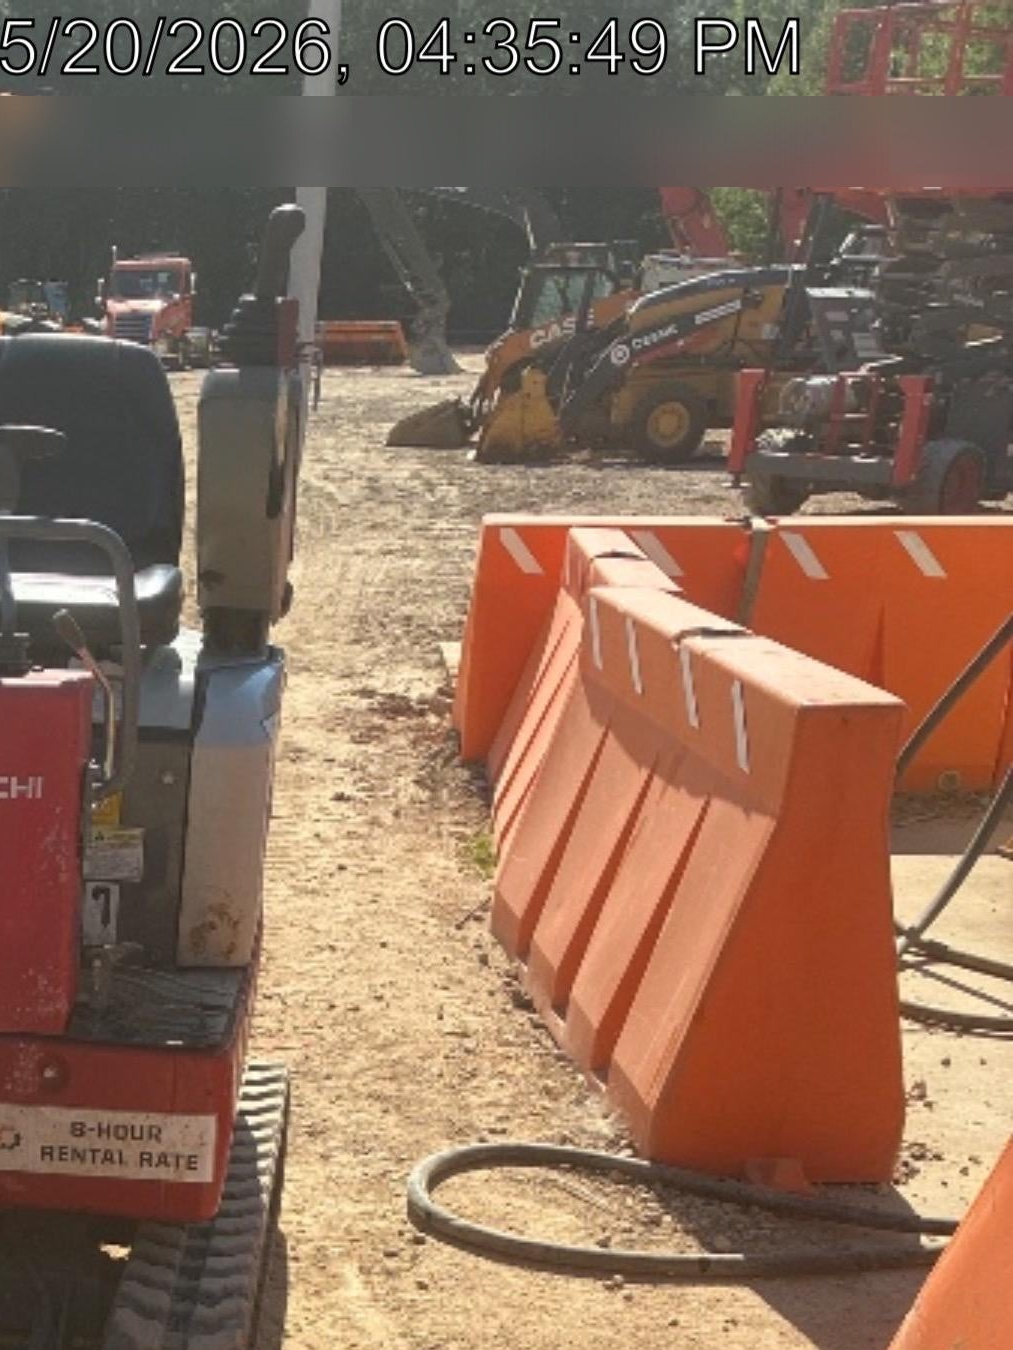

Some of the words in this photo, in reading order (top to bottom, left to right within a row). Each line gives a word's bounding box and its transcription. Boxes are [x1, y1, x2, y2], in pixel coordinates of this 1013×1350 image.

[69, 1120, 163, 1145] 8-HOUR
[39, 1145, 126, 1167] RENTAL
[139, 1150, 199, 1171] RATE
